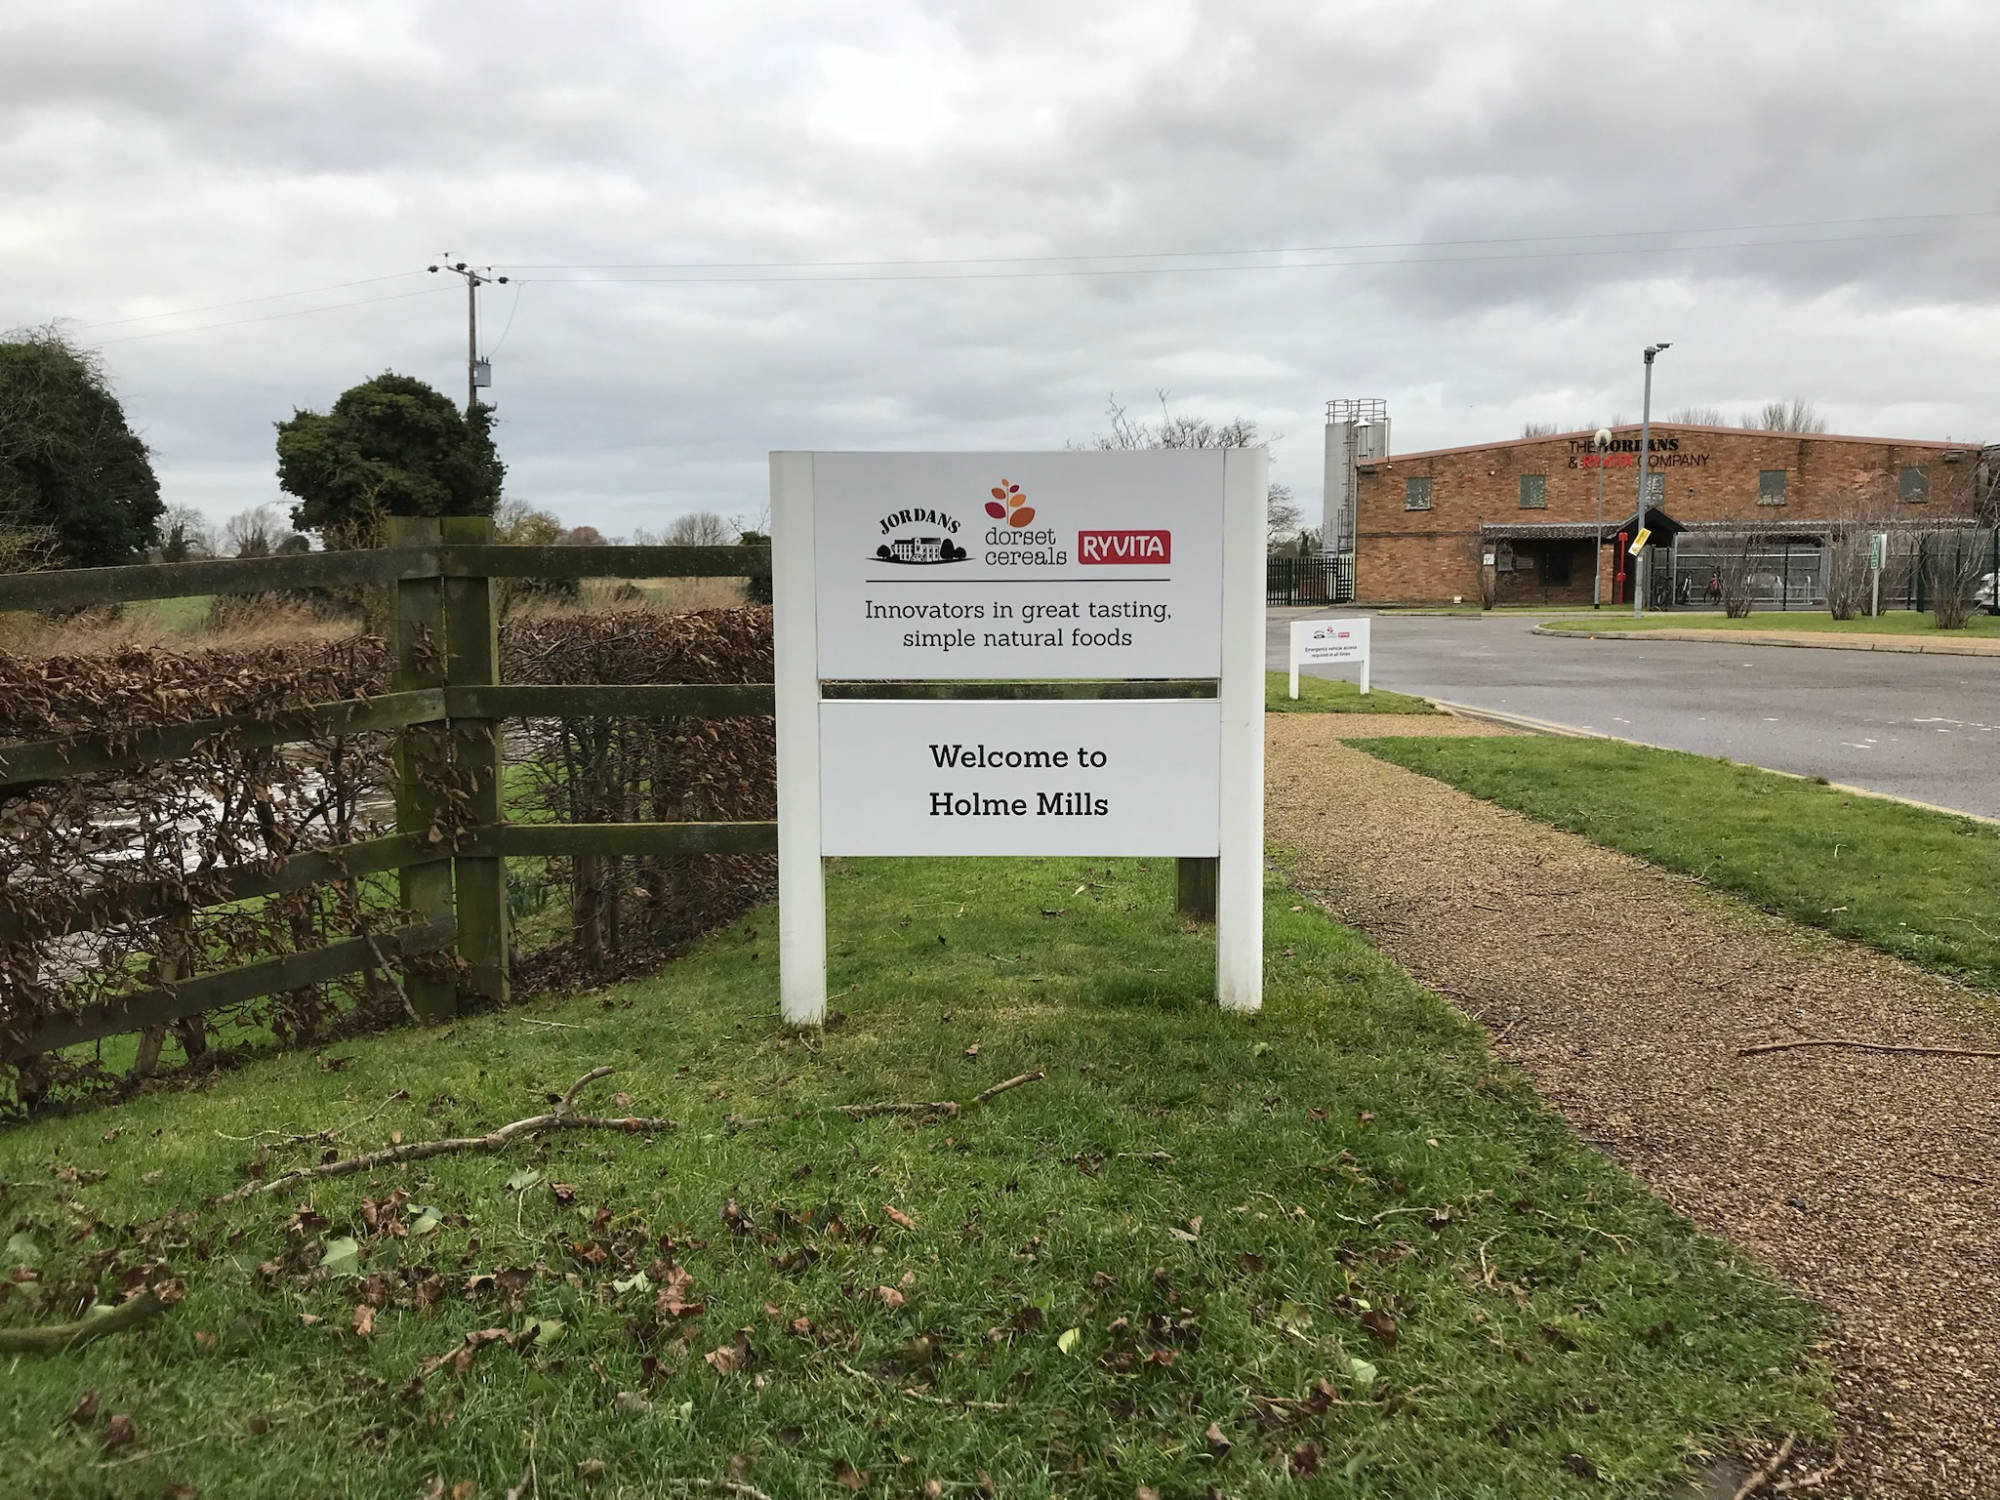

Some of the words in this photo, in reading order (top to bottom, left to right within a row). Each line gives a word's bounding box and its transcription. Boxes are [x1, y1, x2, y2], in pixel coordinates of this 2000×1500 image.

[1568, 441, 1595, 453] THE
[880, 508, 961, 535] JORDANS
[985, 527, 1056, 546] dorset
[1083, 535, 1165, 561] RYVITA
[985, 547, 1067, 566] cereals
[865, 600, 985, 619] Innovators
[993, 601, 1013, 619] in
[1022, 602, 1080, 623] great
[1088, 601, 1172, 623] tasting,
[903, 628, 976, 652] simple
[984, 628, 1063, 647] natural
[1072, 628, 1133, 647] foods
[929, 744, 1068, 768] Welcome
[1077, 747, 1107, 768] to
[929, 792, 1027, 816] Holme
[1036, 792, 1109, 816] Mills
